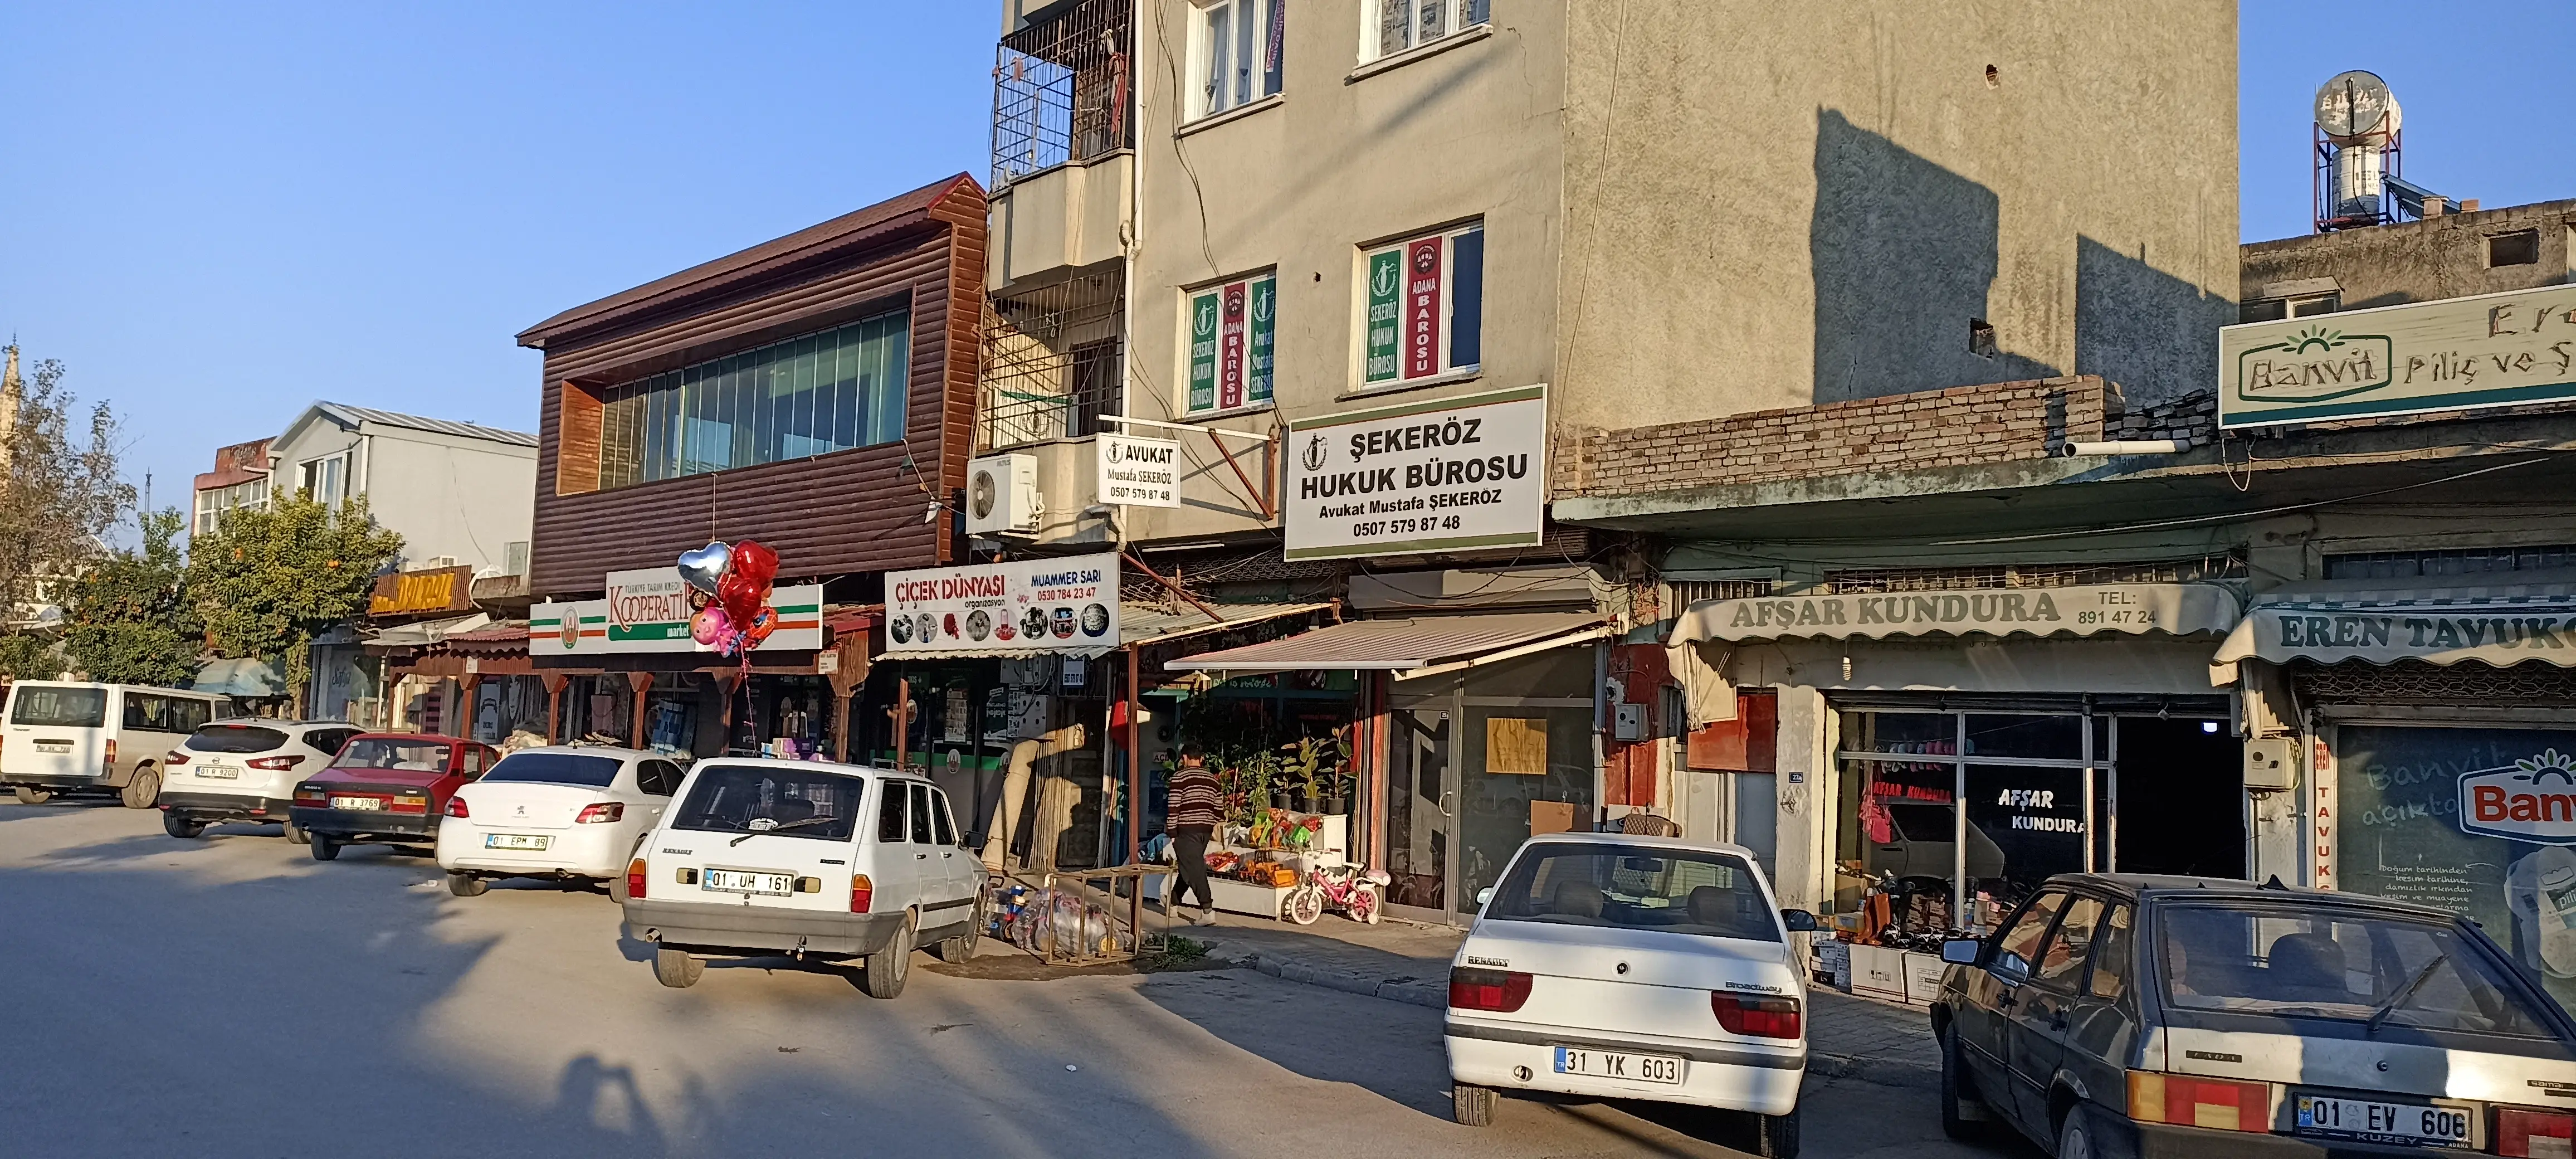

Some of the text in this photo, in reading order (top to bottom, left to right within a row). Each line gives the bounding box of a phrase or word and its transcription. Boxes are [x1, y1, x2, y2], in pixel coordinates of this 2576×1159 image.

[1412, 277, 1436, 294] ADANA
[1370, 299, 1397, 325] ŞEKERÖZ
[1224, 321, 1243, 335] ADANA
[1372, 326, 1394, 347] HUKUK
[1416, 295, 1430, 371] BAROSU
[1255, 330, 1273, 347] Avukat
[1193, 338, 1214, 359] ŞEKERÖZ
[1252, 352, 1273, 370] Mustafa
[1369, 353, 1394, 376] BÜROSU
[2248, 348, 2378, 391] Banvit
[2404, 351, 2480, 386] Piliç
[2492, 352, 2536, 374] ve
[1193, 362, 1212, 381] HUKUK
[1226, 337, 1238, 405] BAROSU
[1191, 387, 1213, 406] BÜROSU
[1350, 416, 1481, 462] ŞEKERÖZ
[1125, 445, 1173, 464] AVUKAT
[1108, 468, 1172, 486] Mustafa ŞEKERÖZ
[1301, 454, 1528, 500] HUKUK BÜROSU
[1110, 486, 1170, 500] 0507 579 87 48
[1319, 488, 1502, 518] Avukat Mustafa ŞEKERÖZ
[1353, 515, 1460, 537] 0507 579 87 48
[1031, 569, 1101, 587] MUAMMER SARI
[647, 583, 663, 592] TARIM
[895, 573, 1005, 610] ÇİÇEK DÜNYASI
[1037, 587, 1096, 601] 0530 784 23 47
[965, 598, 1005, 610] organizasyon
[2097, 591, 2136, 606] TEL:
[1730, 591, 2062, 630] AFŞAR KUNDURA
[2078, 610, 2157, 625] 891 47 24
[667, 624, 690, 637] market
[2279, 615, 2392, 647] EREN
[1874, 781, 1901, 796] AFŞAR
[1998, 789, 2053, 811] AFŞAR
[493, 836, 545, 847] 01 EPM 89
[2318, 787, 2330, 889] TAVUK
[2382, 865, 2467, 874] Doğum tarihinden
[713, 873, 788, 891] 01 UH 161
[2385, 883, 2426, 891] damızlık
[2427, 875, 2468, 885] tarihine,
[2427, 895, 2469, 905] muayene
[1725, 981, 1782, 994] Broadway
[1567, 1051, 1675, 1080] 31 YK 603
[2314, 1100, 2466, 1138] 01 EV 606
[2357, 1133, 2418, 1145] KUZEY
